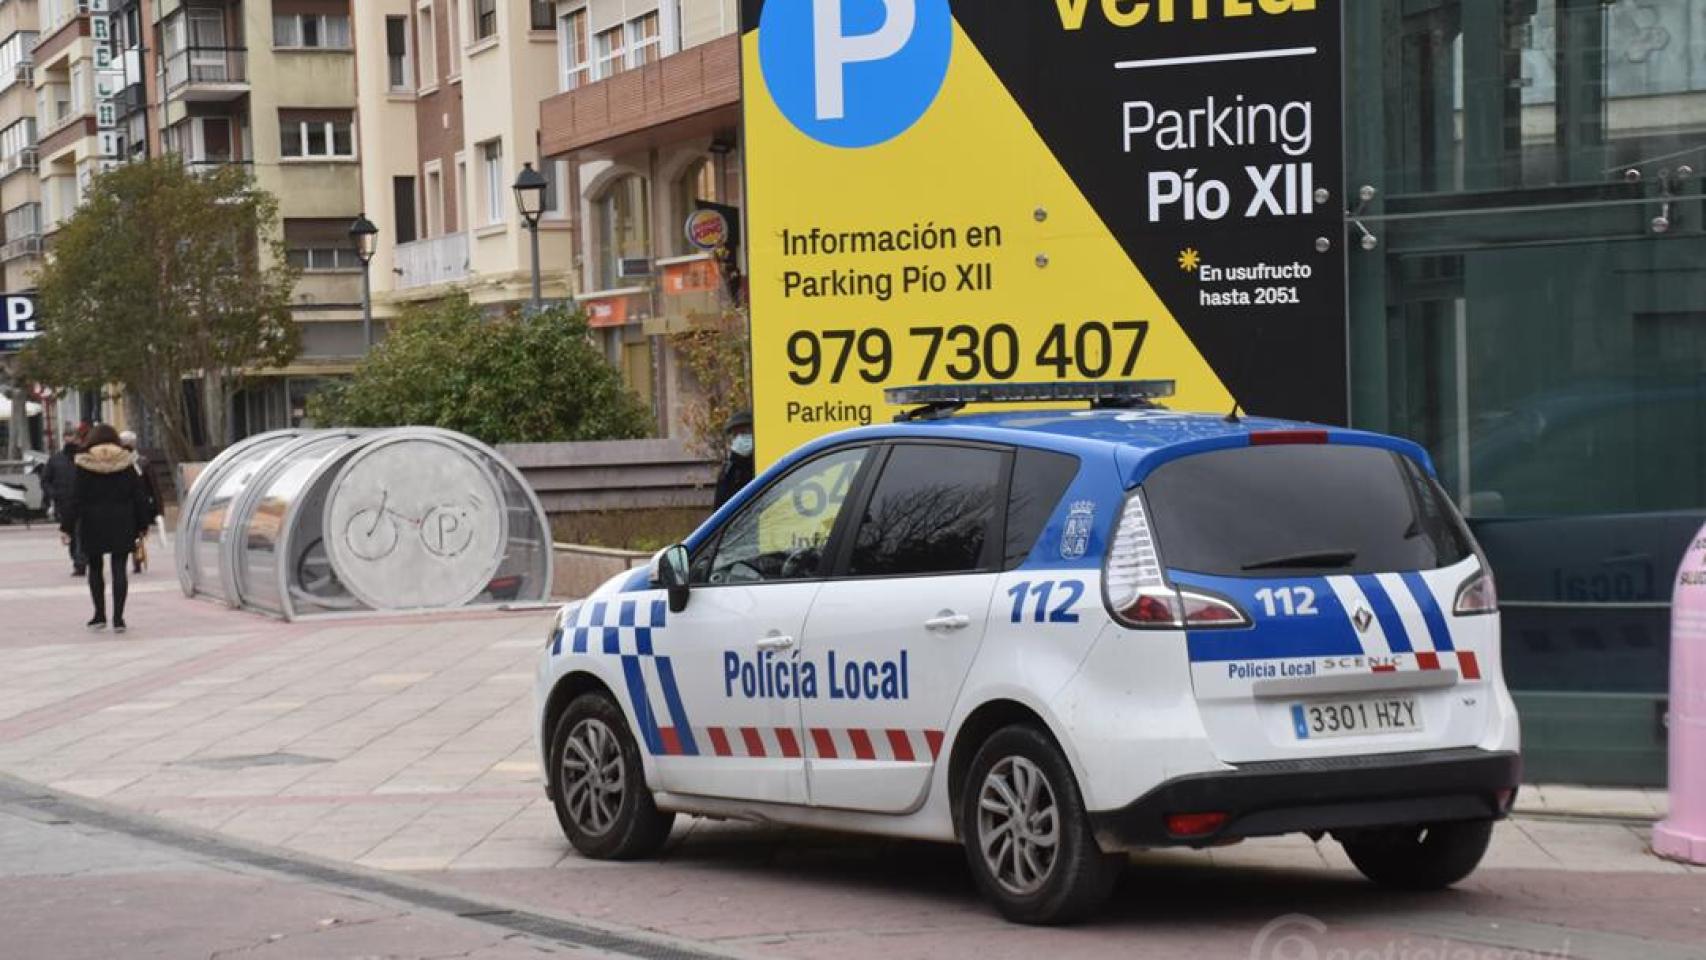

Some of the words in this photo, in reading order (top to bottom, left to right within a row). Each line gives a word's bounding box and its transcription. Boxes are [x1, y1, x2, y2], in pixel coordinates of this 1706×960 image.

[812, 0, 916, 120] P
[1122, 94, 1312, 156] Parking
[1147, 168, 1231, 222] Pío
[1244, 162, 1314, 217] XII
[783, 222, 956, 256] Información
[965, 225, 1002, 248] en
[783, 270, 893, 301] Parking
[902, 266, 947, 294] Pío
[955, 263, 993, 291] XII
[1199, 265, 1222, 281] En
[1225, 262, 1312, 281] usufructo
[1199, 287, 1250, 306] hasta
[1253, 286, 1299, 304] 2051
[786, 327, 893, 386] 979
[909, 323, 1020, 382] 730
[1035, 320, 1149, 379] 407
[787, 400, 872, 426] Parking
[1008, 580, 1085, 623] 112
[1254, 586, 1318, 617] 112
[724, 650, 818, 699] Policía
[828, 649, 909, 699] Local
[1281, 661, 1317, 677] Local
[1323, 654, 1403, 669] SCENIC
[1310, 706, 1369, 733] 3301
[1376, 700, 1416, 728] HZY
